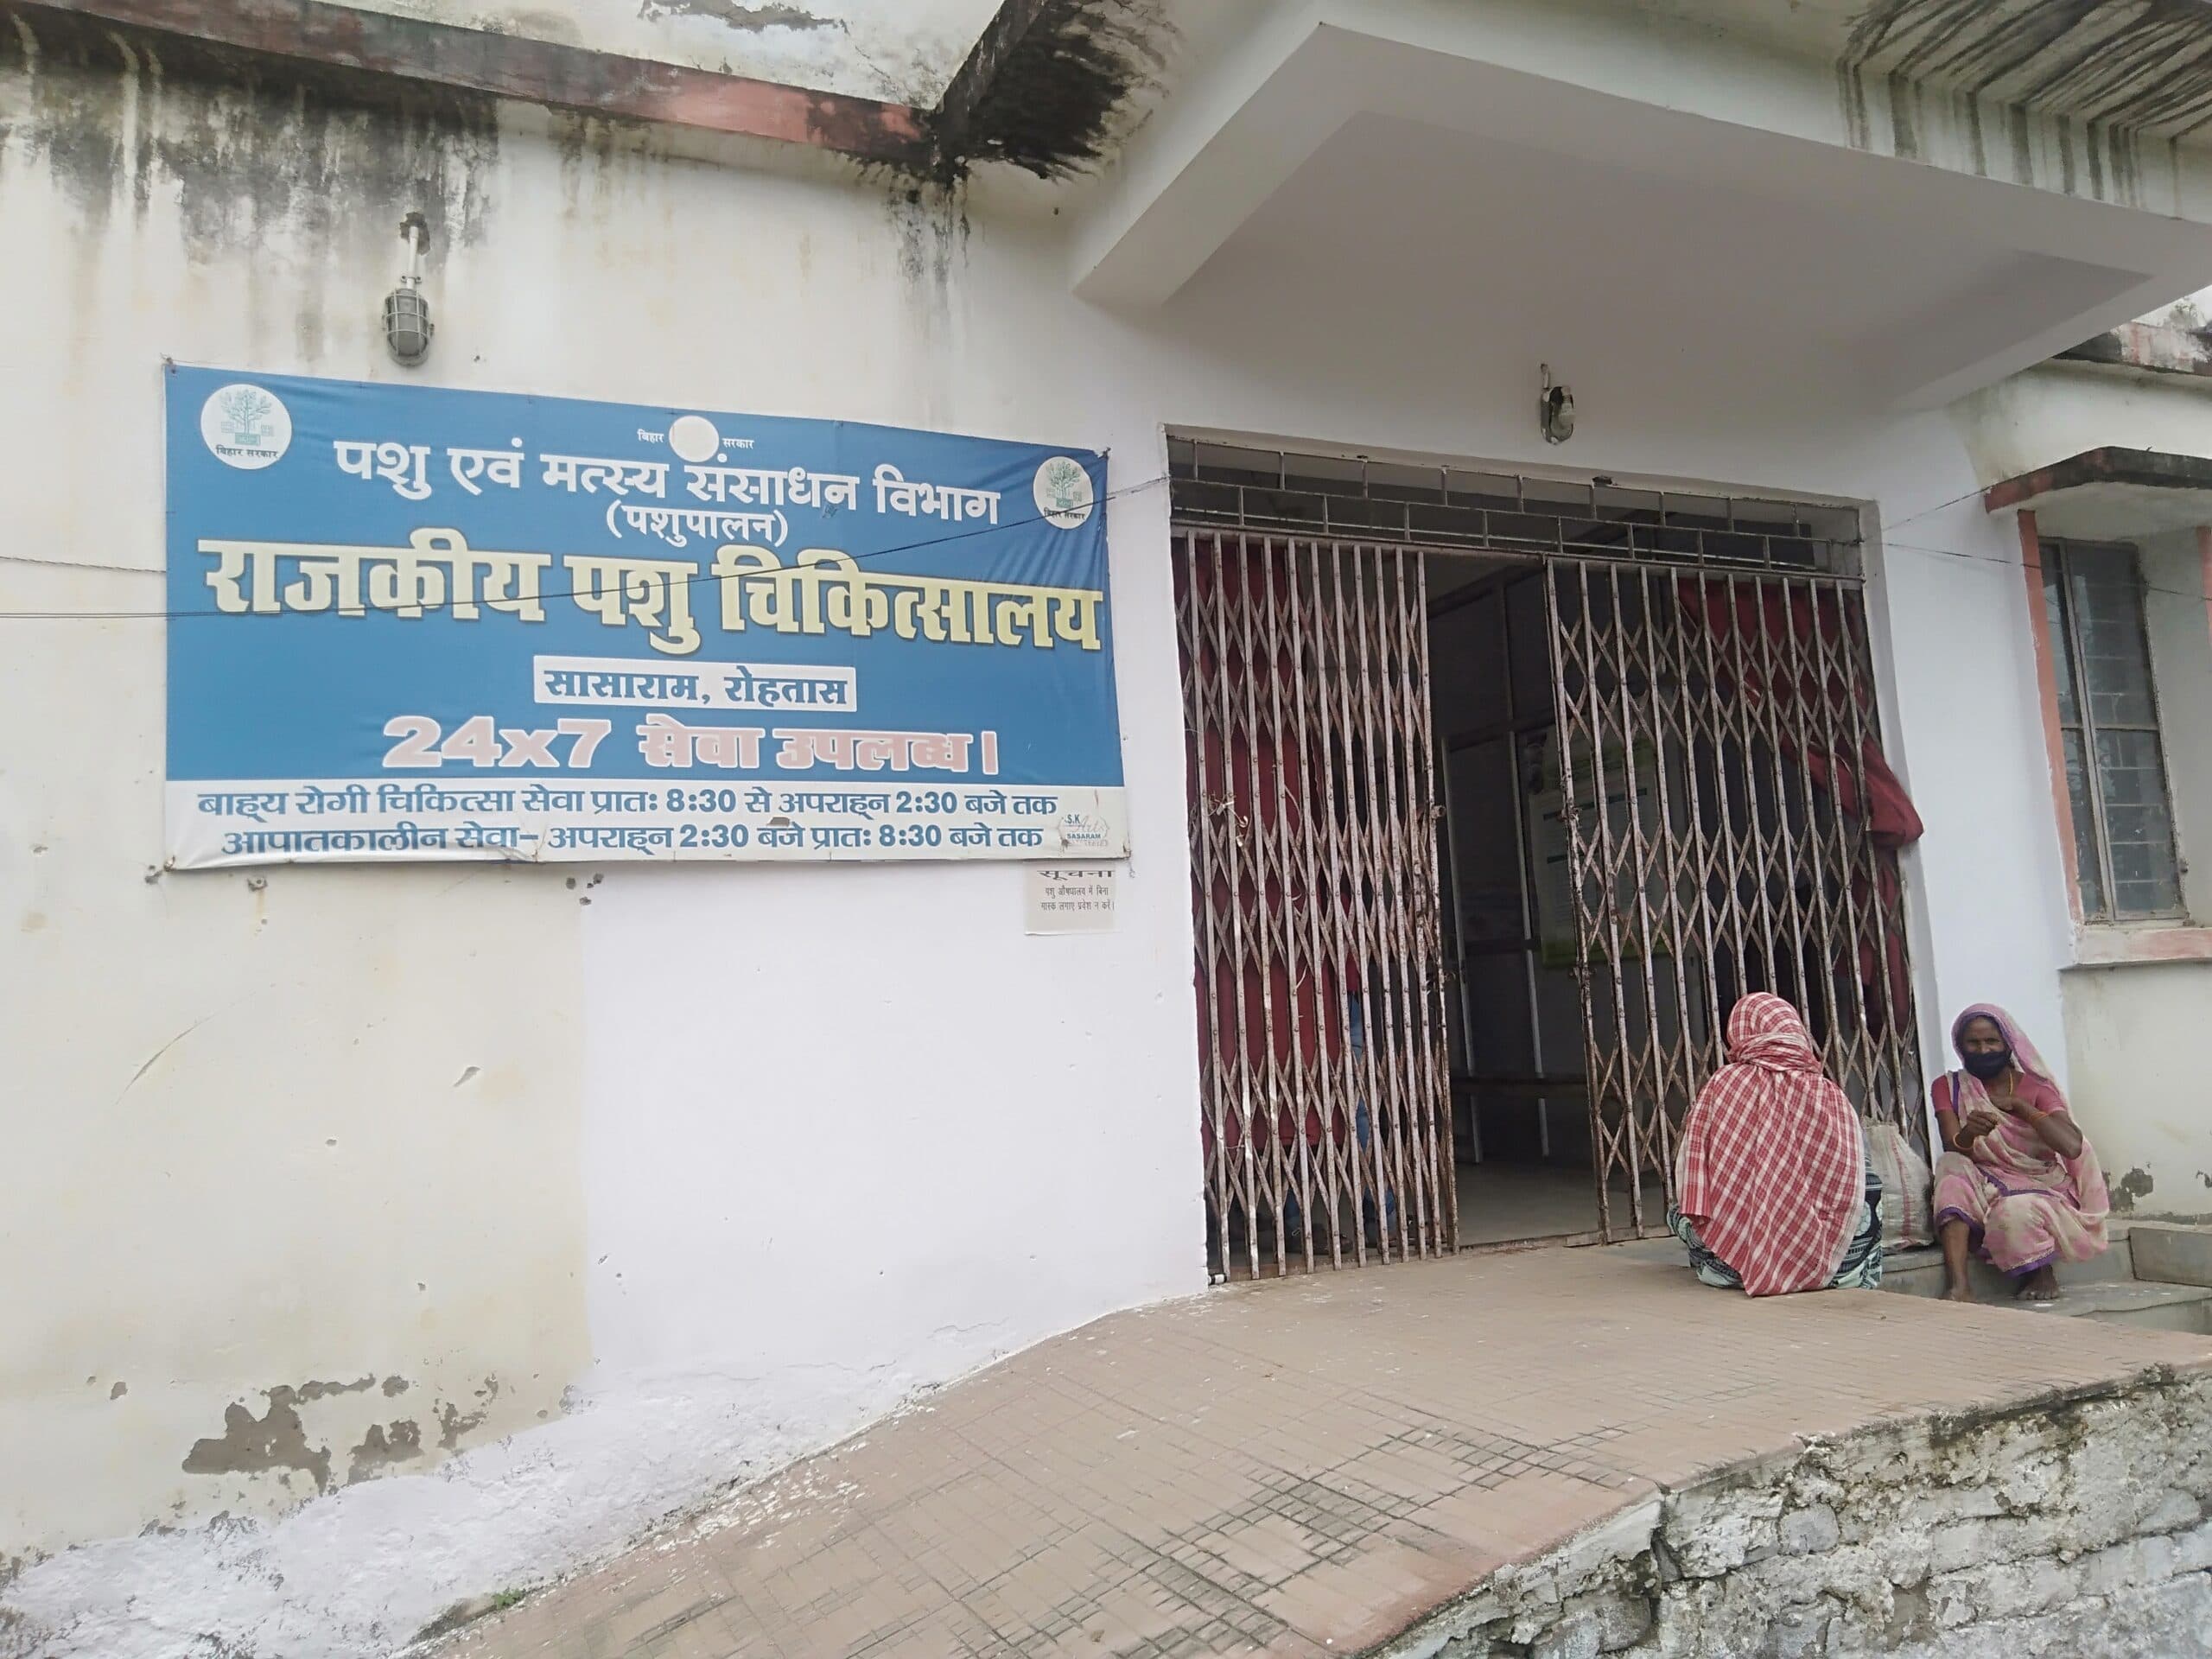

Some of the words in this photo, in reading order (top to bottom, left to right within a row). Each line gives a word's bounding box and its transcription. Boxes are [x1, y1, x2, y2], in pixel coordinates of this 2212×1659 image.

[216, 444, 245, 457] बिहार
[246, 448, 278, 458] सरकार
[637, 429, 664, 443] बिहार
[722, 438, 754, 449] सरकार
[334, 440, 432, 500] पशु
[447, 438, 524, 495] एवं
[540, 454, 670, 499] मत्स्य
[684, 453, 860, 511] संसाधन
[873, 463, 1001, 524] विभाग
[607, 499, 788, 547] (पशुपालन)
[198, 528, 551, 621] राजकीय
[563, 555, 700, 655] पशु
[710, 544, 1104, 651] चिकित्सालय
[543, 670, 710, 706] सासाराम,
[724, 666, 848, 707] रोहतास
[382, 715, 612, 768] 24x7
[636, 713, 766, 769] सेवा
[198, 793, 289, 823] बाह्य
[295, 784, 371, 814] रोगी
[376, 783, 515, 813] चिकित्सा
[521, 784, 585, 812] सेवा
[666, 789, 735, 812] 8:30
[744, 786, 772, 813] से
[896, 791, 957, 814] 2:30
[964, 790, 1007, 815] बजे
[1013, 795, 1058, 815] तक
[221, 821, 448, 854] आपातकालीन
[679, 824, 749, 848] 2:30
[757, 823, 810, 848] बजे
[879, 824, 942, 848] 8:30
[950, 823, 993, 848] बजे
[998, 827, 1044, 847] तक
[1037, 870, 1116, 880] सूचना
[1046, 887, 1056, 899] पशु
[1096, 885, 1109, 896] बिना
